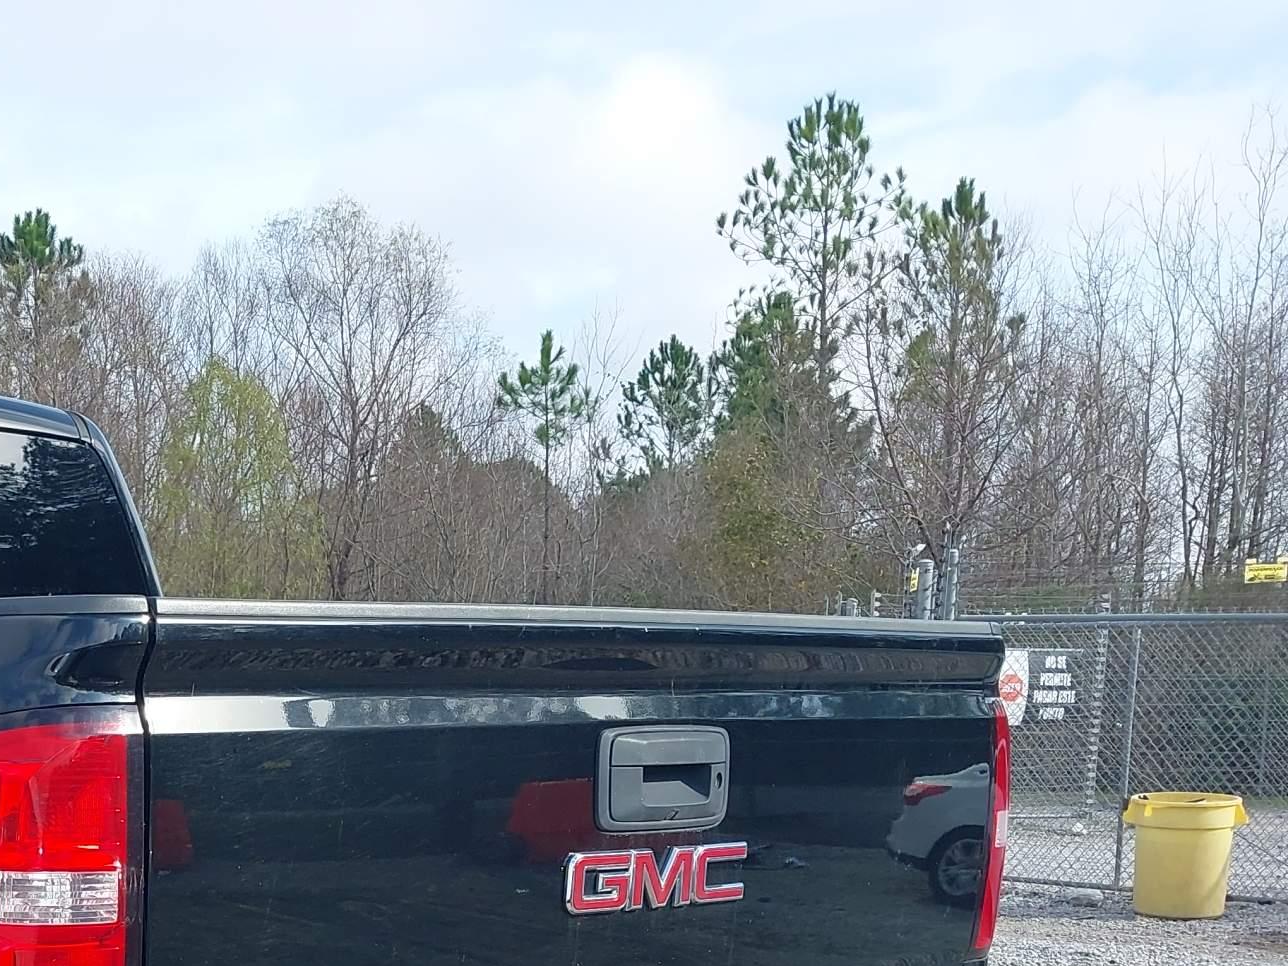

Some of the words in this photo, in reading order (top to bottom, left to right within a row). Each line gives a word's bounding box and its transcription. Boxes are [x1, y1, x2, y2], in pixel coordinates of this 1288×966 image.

[1057, 656, 1067, 669] SE
[1058, 690, 1076, 703] ESTE
[566, 841, 748, 915] GMC
